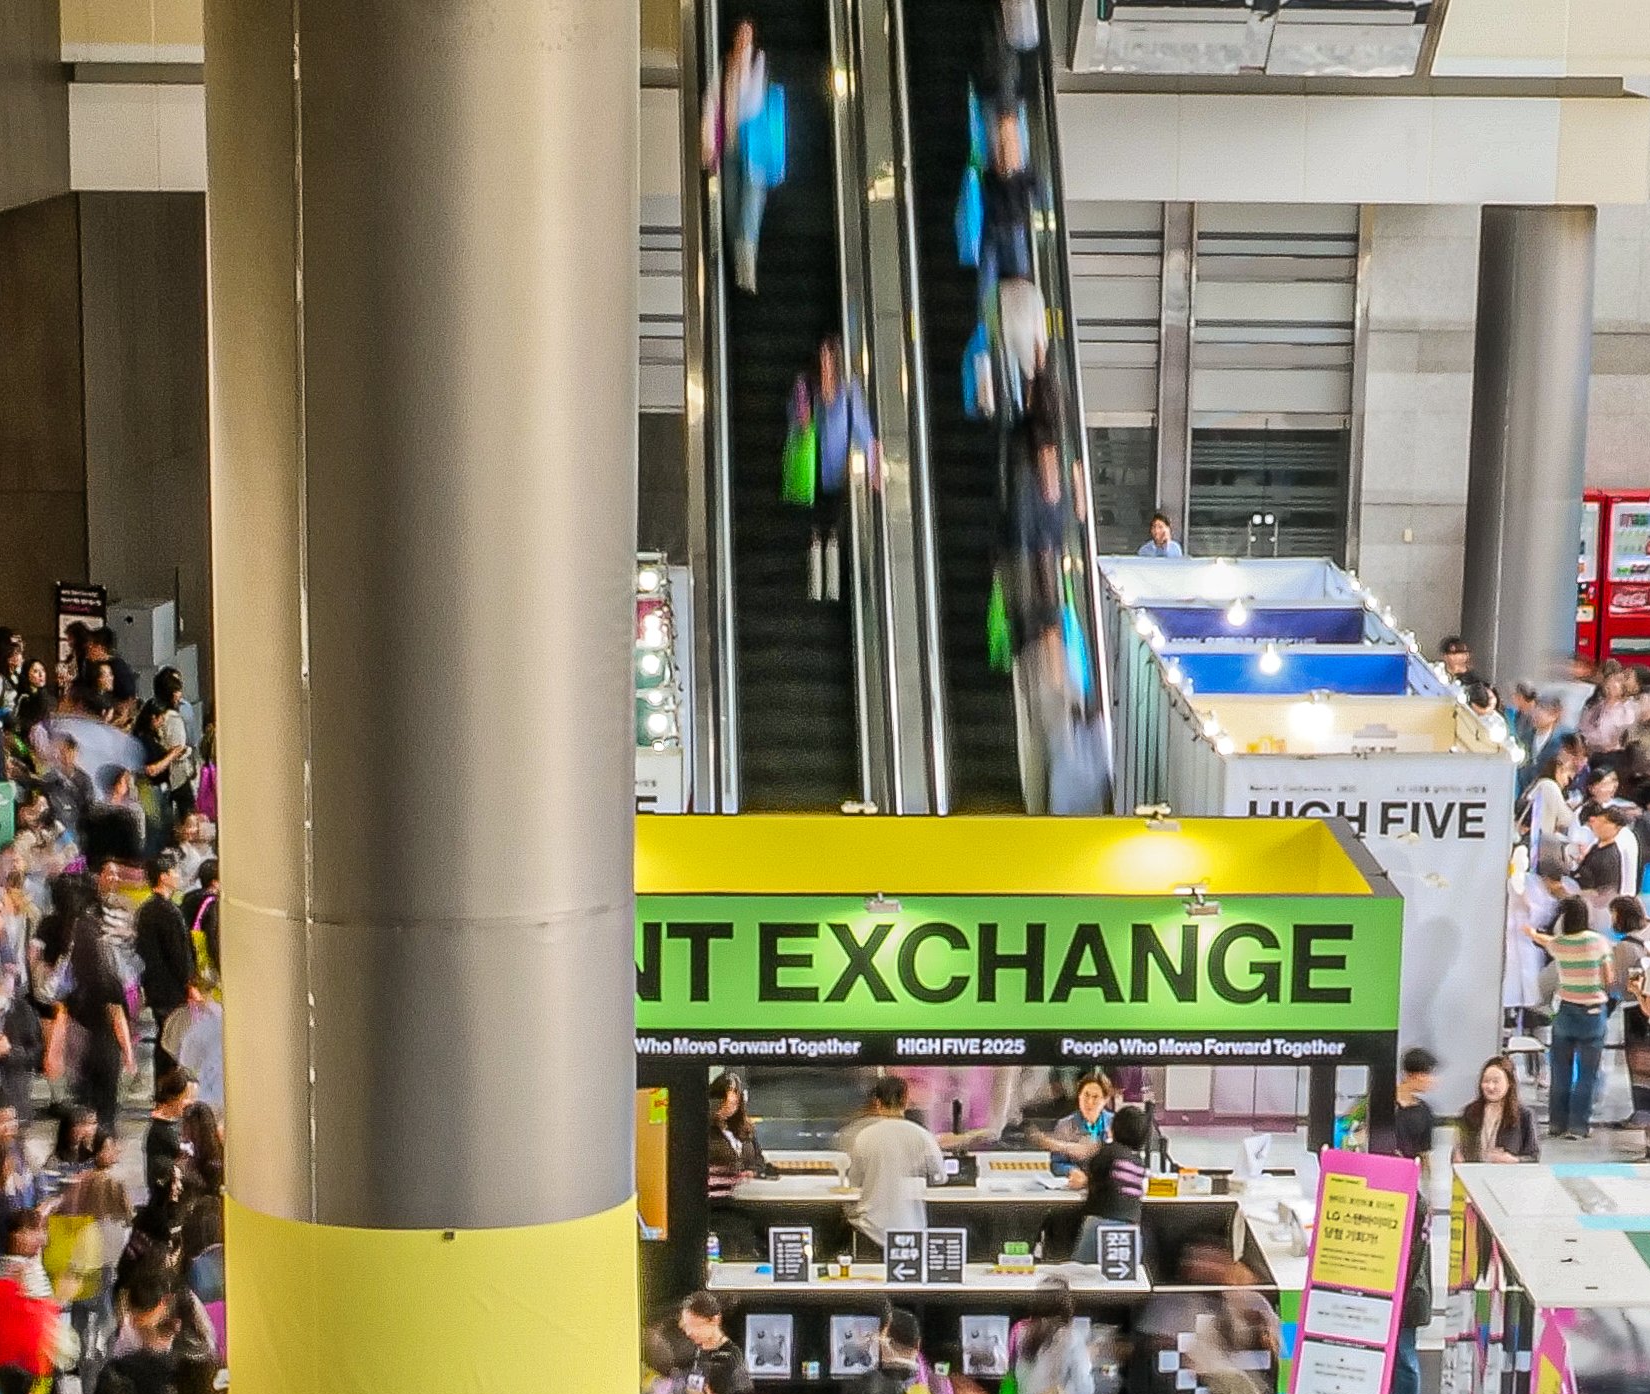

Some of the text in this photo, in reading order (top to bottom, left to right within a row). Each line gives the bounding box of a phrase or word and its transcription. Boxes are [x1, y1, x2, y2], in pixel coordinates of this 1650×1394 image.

[1379, 801, 1487, 839] FIVE
[758, 922, 1354, 1004] EXCHANGE
[635, 1037, 862, 1058] Who Move Forward Together
[896, 1037, 1026, 1055] HIGH FIVE 2025
[1061, 1038, 1346, 1058] People Who Move Forward Together
[1325, 1210, 1340, 1221] LG
